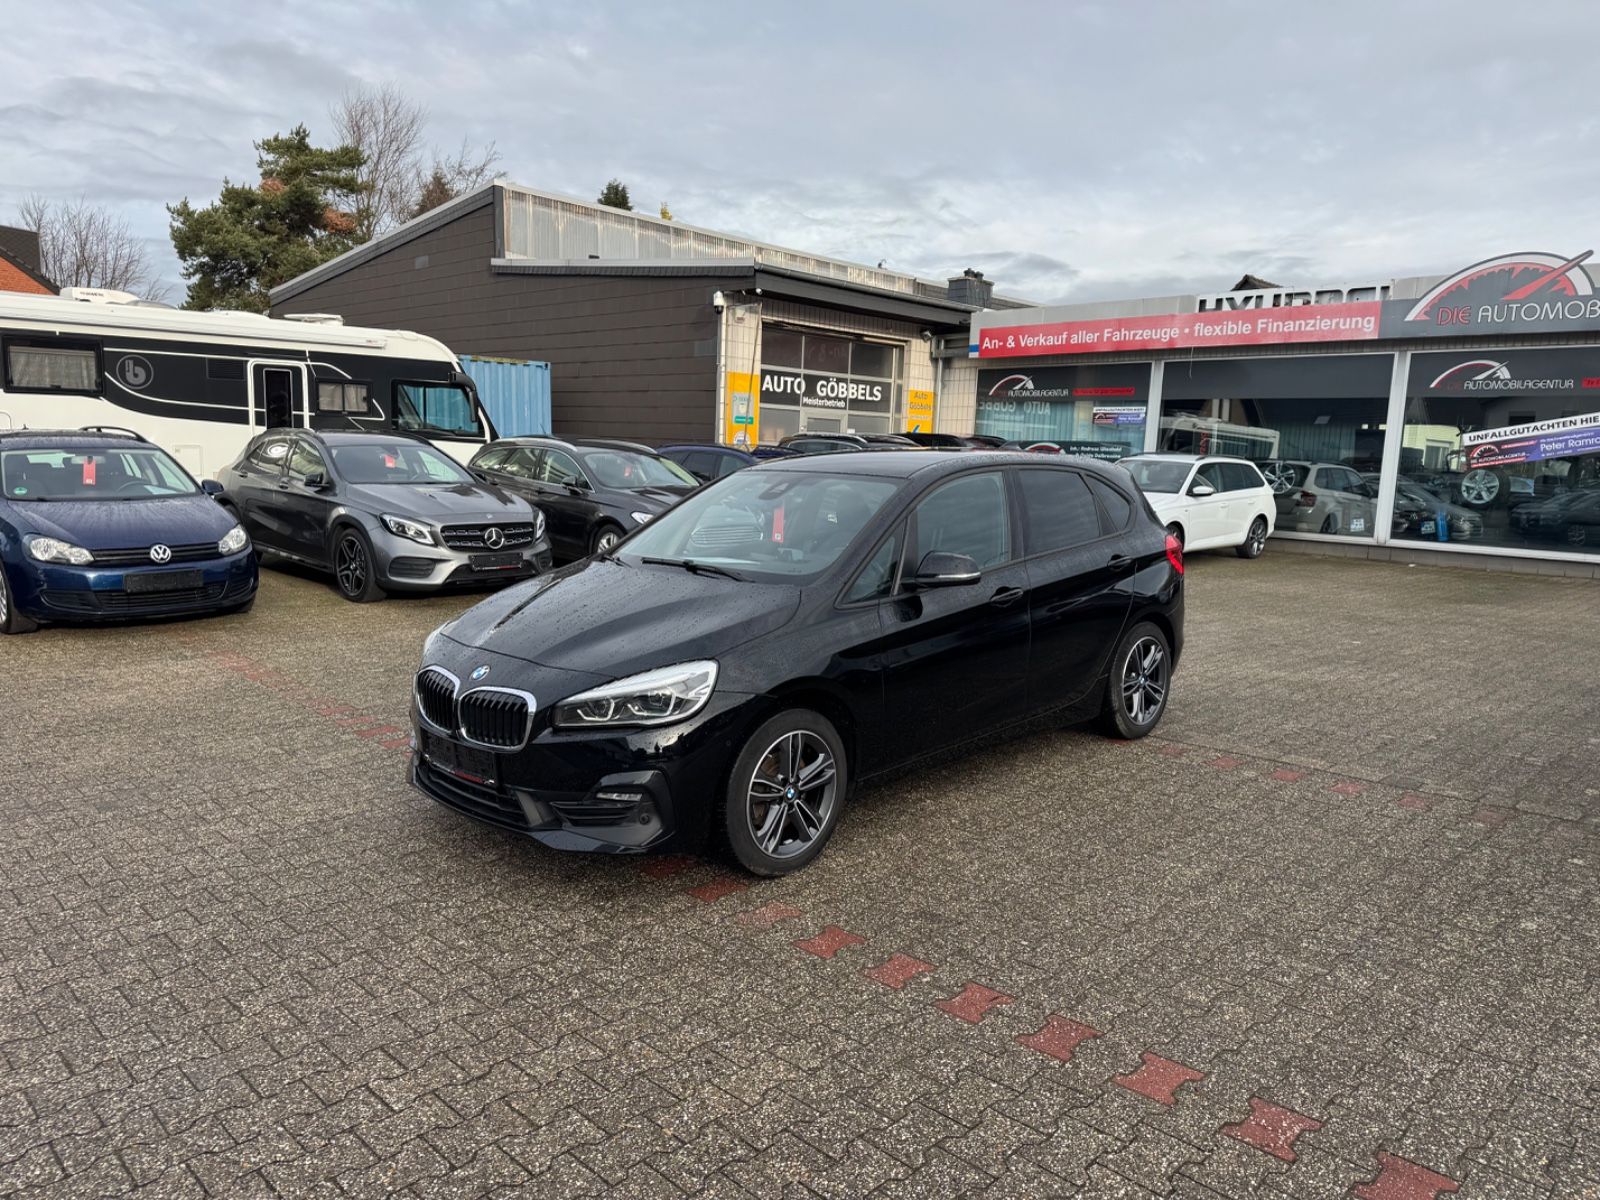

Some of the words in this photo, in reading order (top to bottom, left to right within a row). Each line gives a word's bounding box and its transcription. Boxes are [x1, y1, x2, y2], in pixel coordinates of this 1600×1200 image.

[1436, 306, 1472, 326] DIE
[1477, 299, 1600, 324] AUTOMOB
[982, 337, 1003, 349] An-
[1006, 335, 1016, 348] &
[1019, 333, 1067, 347] Verkauf
[1070, 331, 1100, 345] aller
[1103, 326, 1179, 342] Fahrzeuge
[1194, 320, 1251, 337] flexible
[1257, 315, 1376, 333] Finanzierung
[762, 374, 805, 394] AUTO
[816, 378, 882, 401] GÖBBELS
[1464, 379, 1574, 390] AUTOMOBILAGENTUR
[802, 396, 846, 408] Meisterbetrieb
[1468, 419, 1577, 442] UNFALLGUTACHTEN
[1580, 415, 1600, 425] HIE
[1540, 441, 1565, 452] Peter
